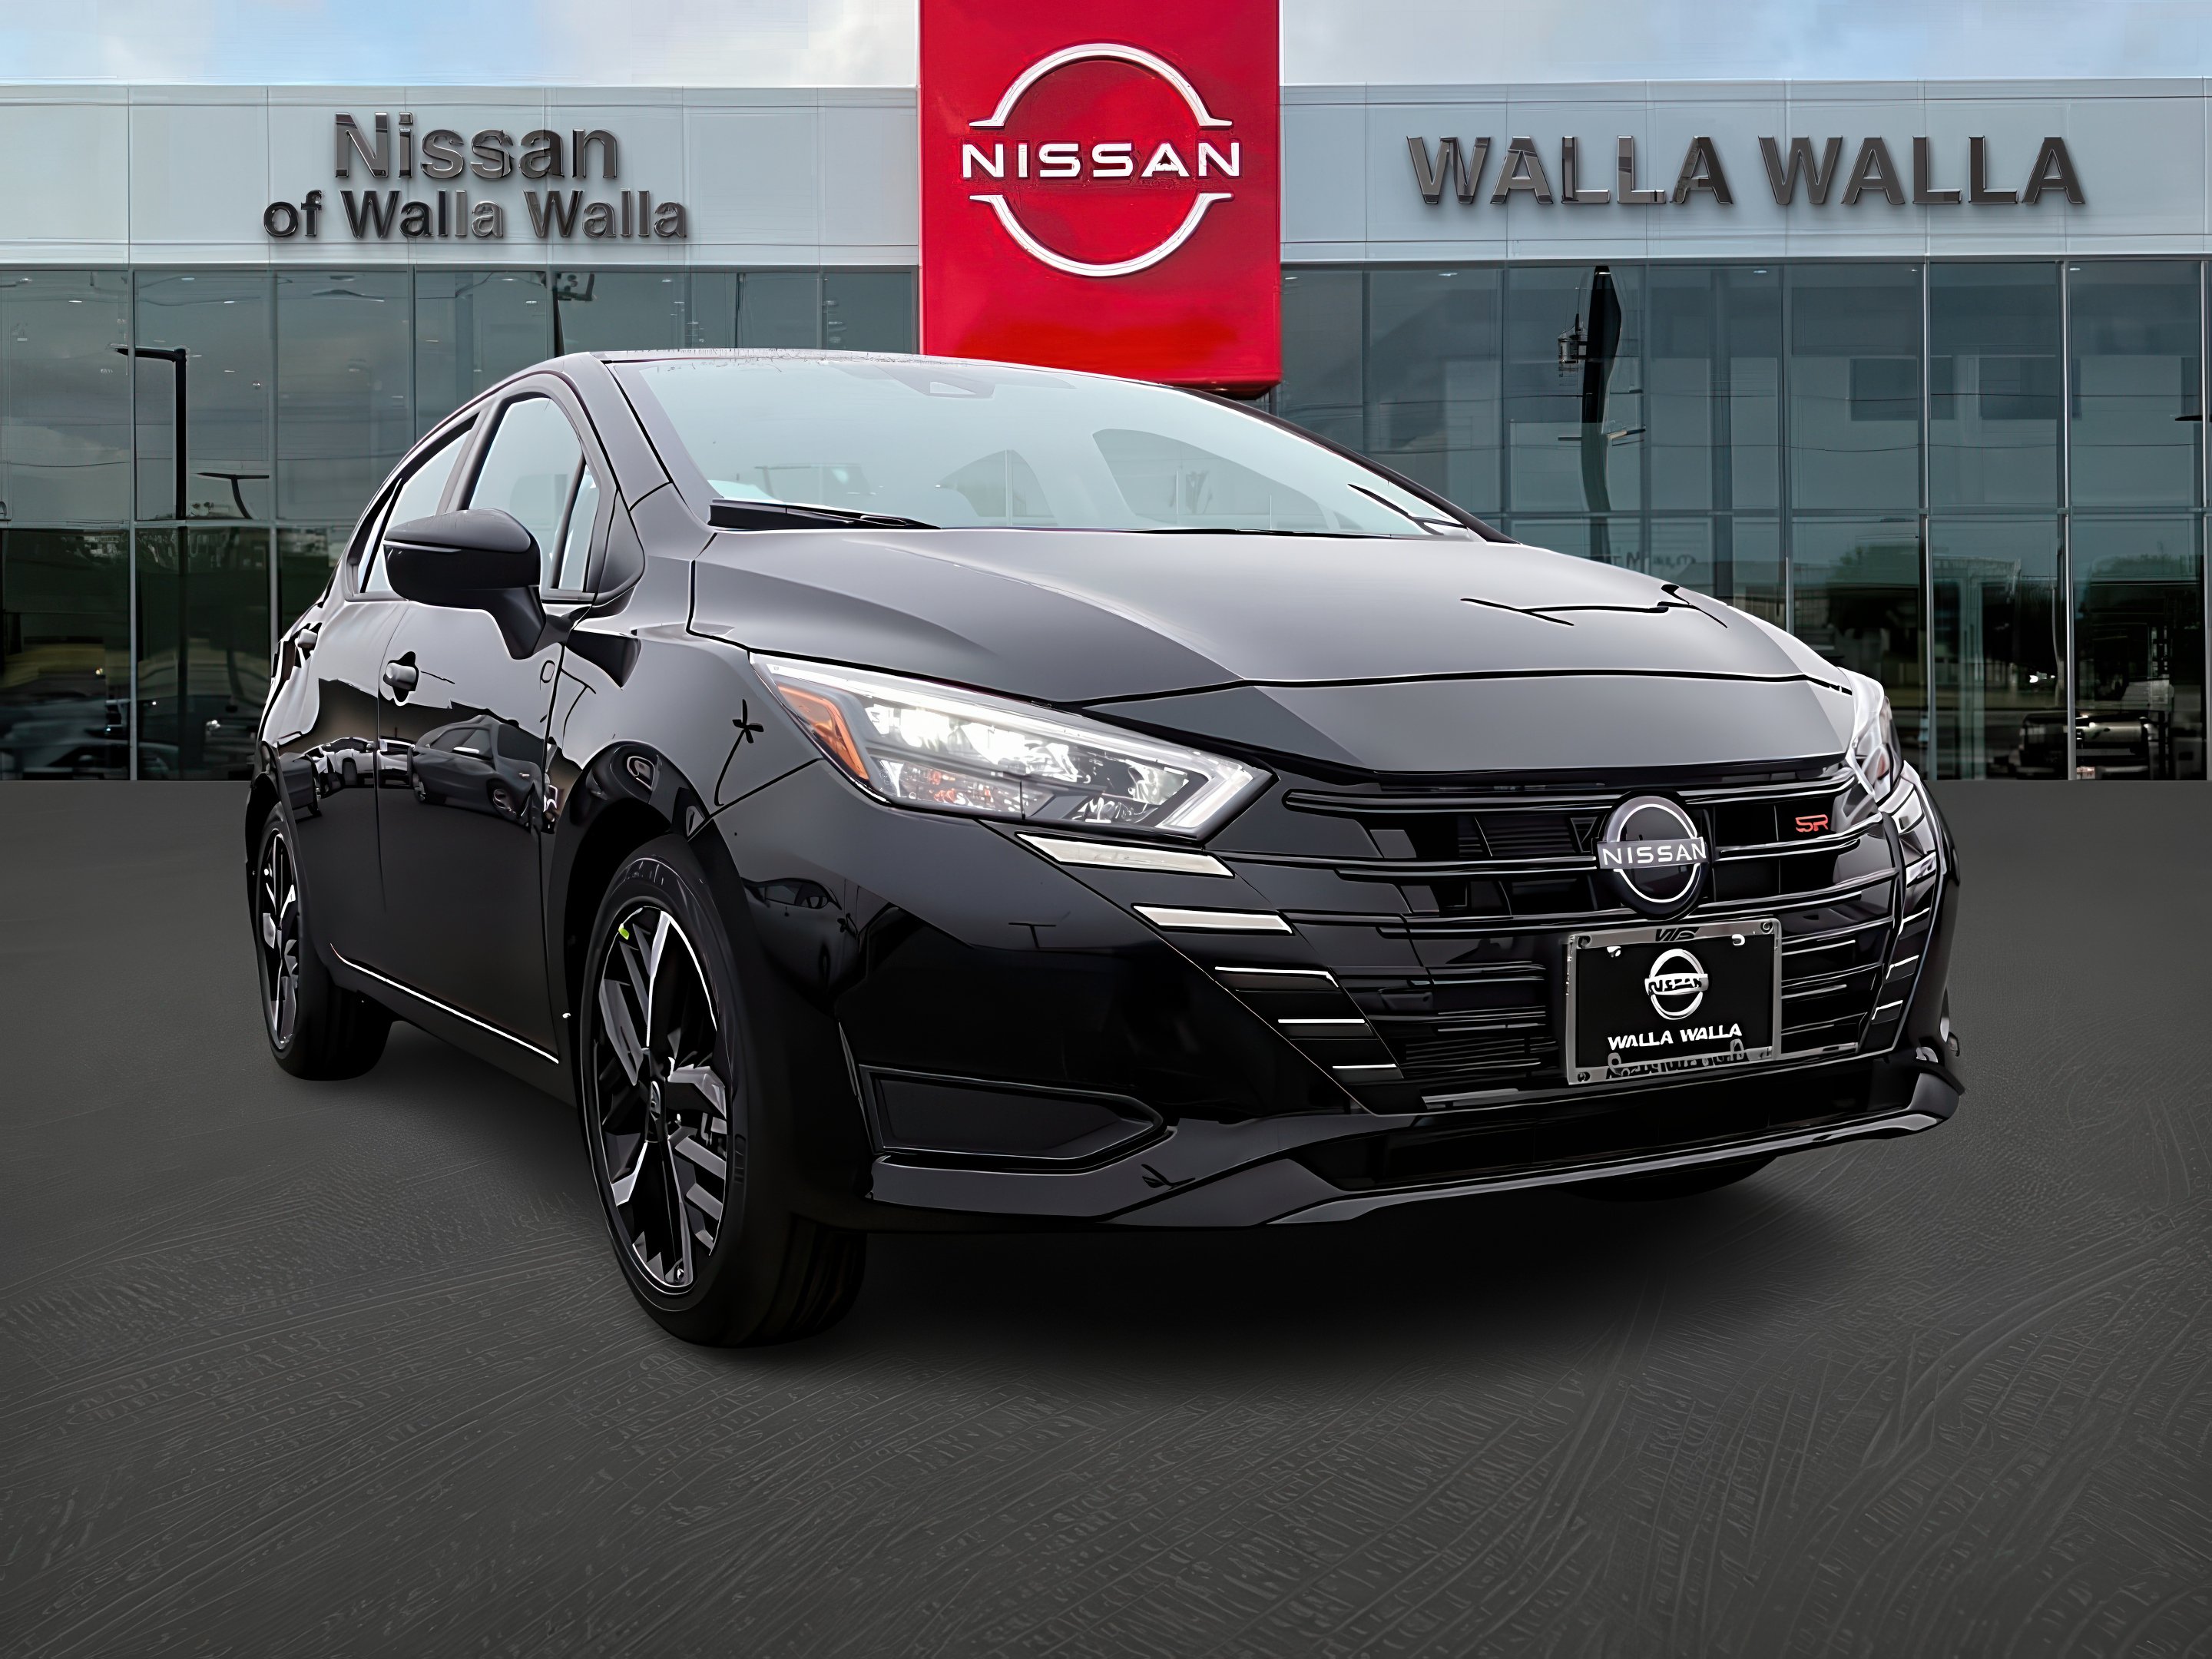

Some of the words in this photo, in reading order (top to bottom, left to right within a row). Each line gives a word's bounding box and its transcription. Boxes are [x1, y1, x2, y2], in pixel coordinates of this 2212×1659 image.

[333, 111, 619, 179] Nissan
[962, 141, 1240, 179] NISSAN
[1406, 134, 1734, 206] WALLA
[1758, 134, 2087, 206] WALLA
[263, 188, 323, 238] of
[339, 188, 505, 239] Walla
[522, 188, 687, 239] Walla
[1795, 813, 1829, 833] SR
[1601, 843, 1707, 866] NISSAN
[1607, 1030, 1674, 1051] WALLA
[1680, 1023, 1742, 1043] WALLA
